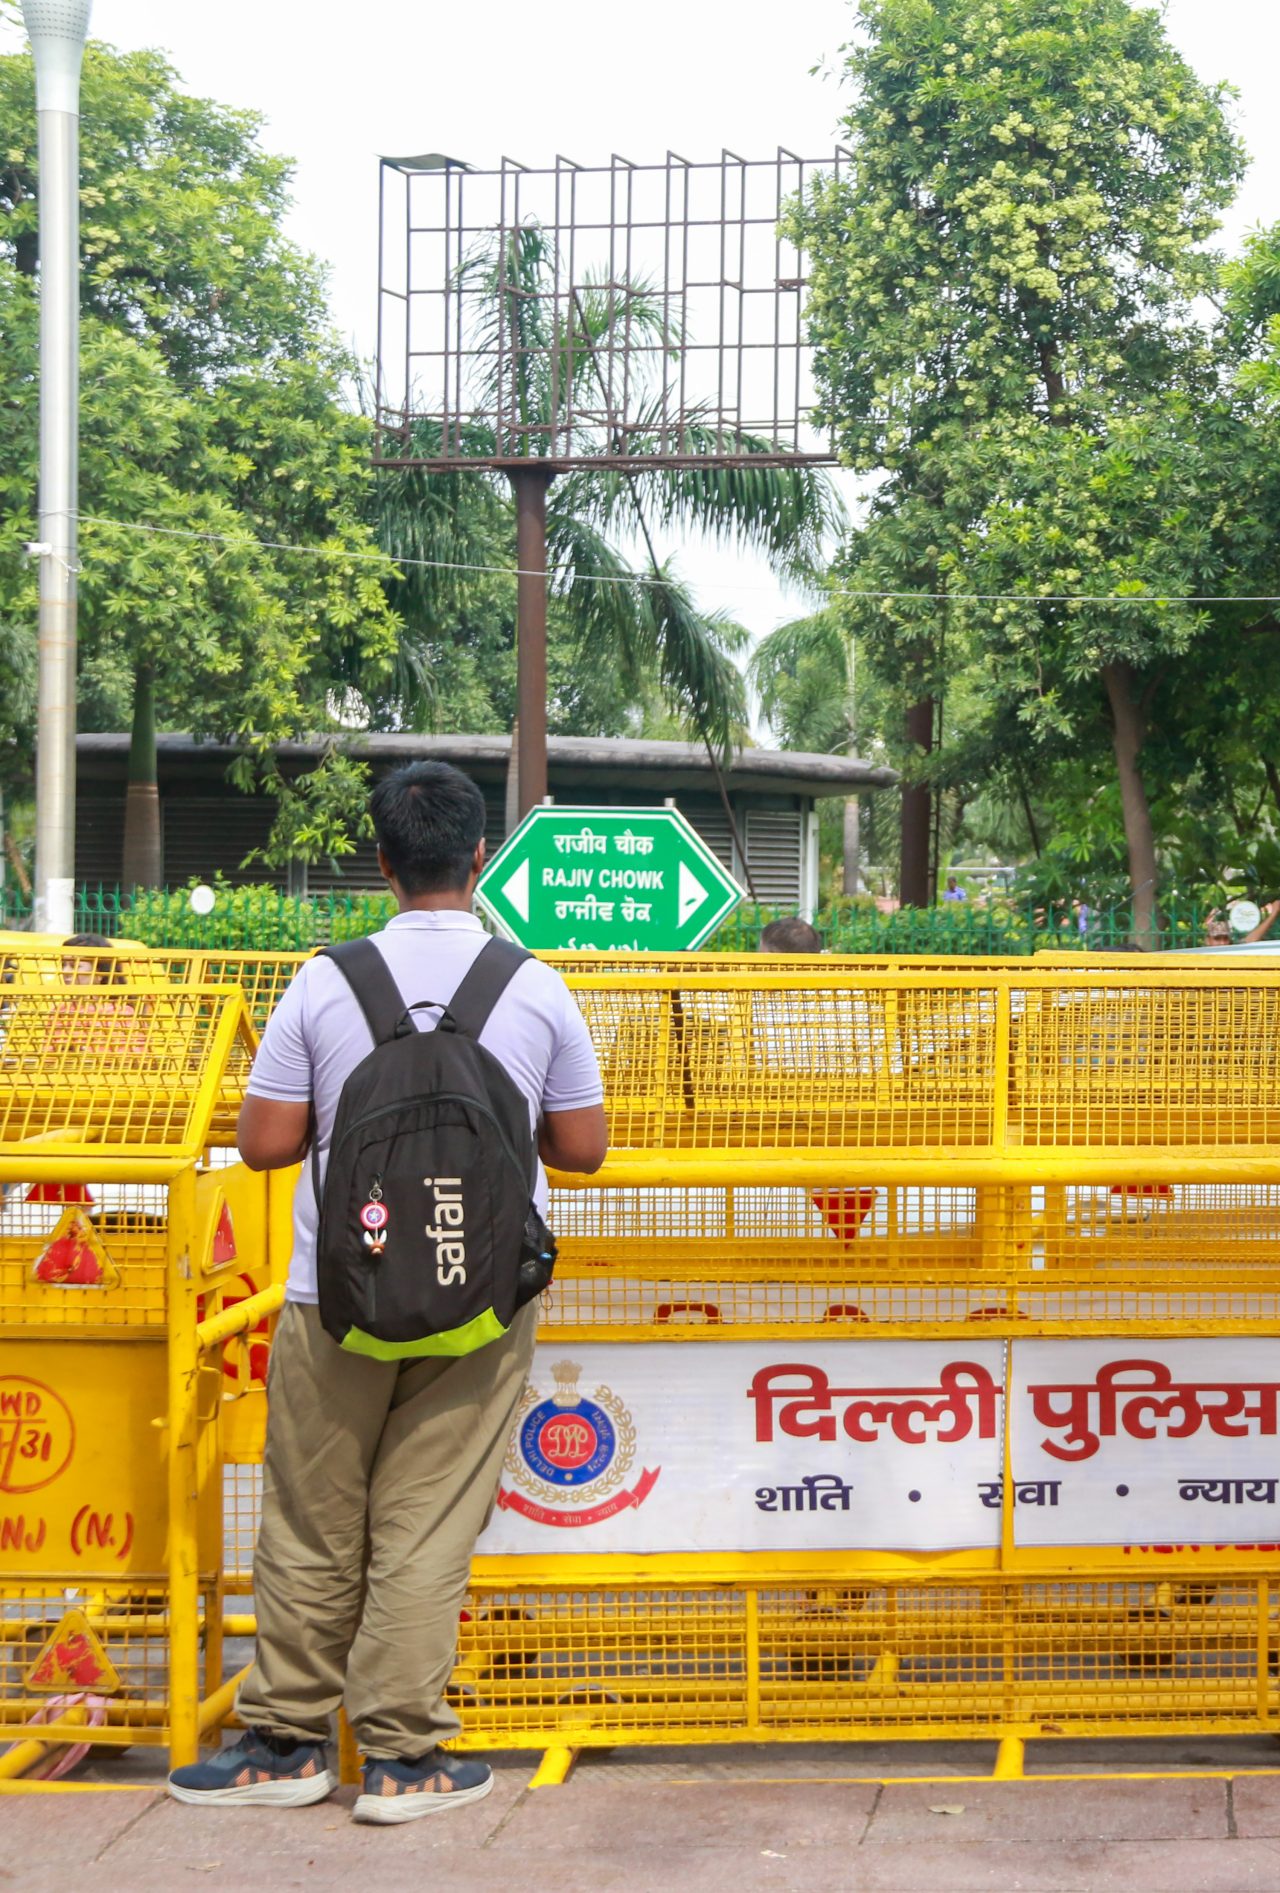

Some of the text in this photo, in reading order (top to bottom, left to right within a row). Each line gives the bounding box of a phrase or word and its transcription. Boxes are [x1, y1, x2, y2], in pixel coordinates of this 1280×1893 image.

[553, 827, 655, 856] राजीव चौक
[542, 868, 664, 889] RAJIV CHOWK
[554, 894, 615, 922] ਰਾਜੀਵ
[423, 1177, 467, 1286] safari
[746, 1360, 1003, 1444] दिल्ली
[525, 1411, 546, 1449] POLICE
[755, 1474, 854, 1512] शांति
[1177, 1479, 1279, 1504] न्याय
